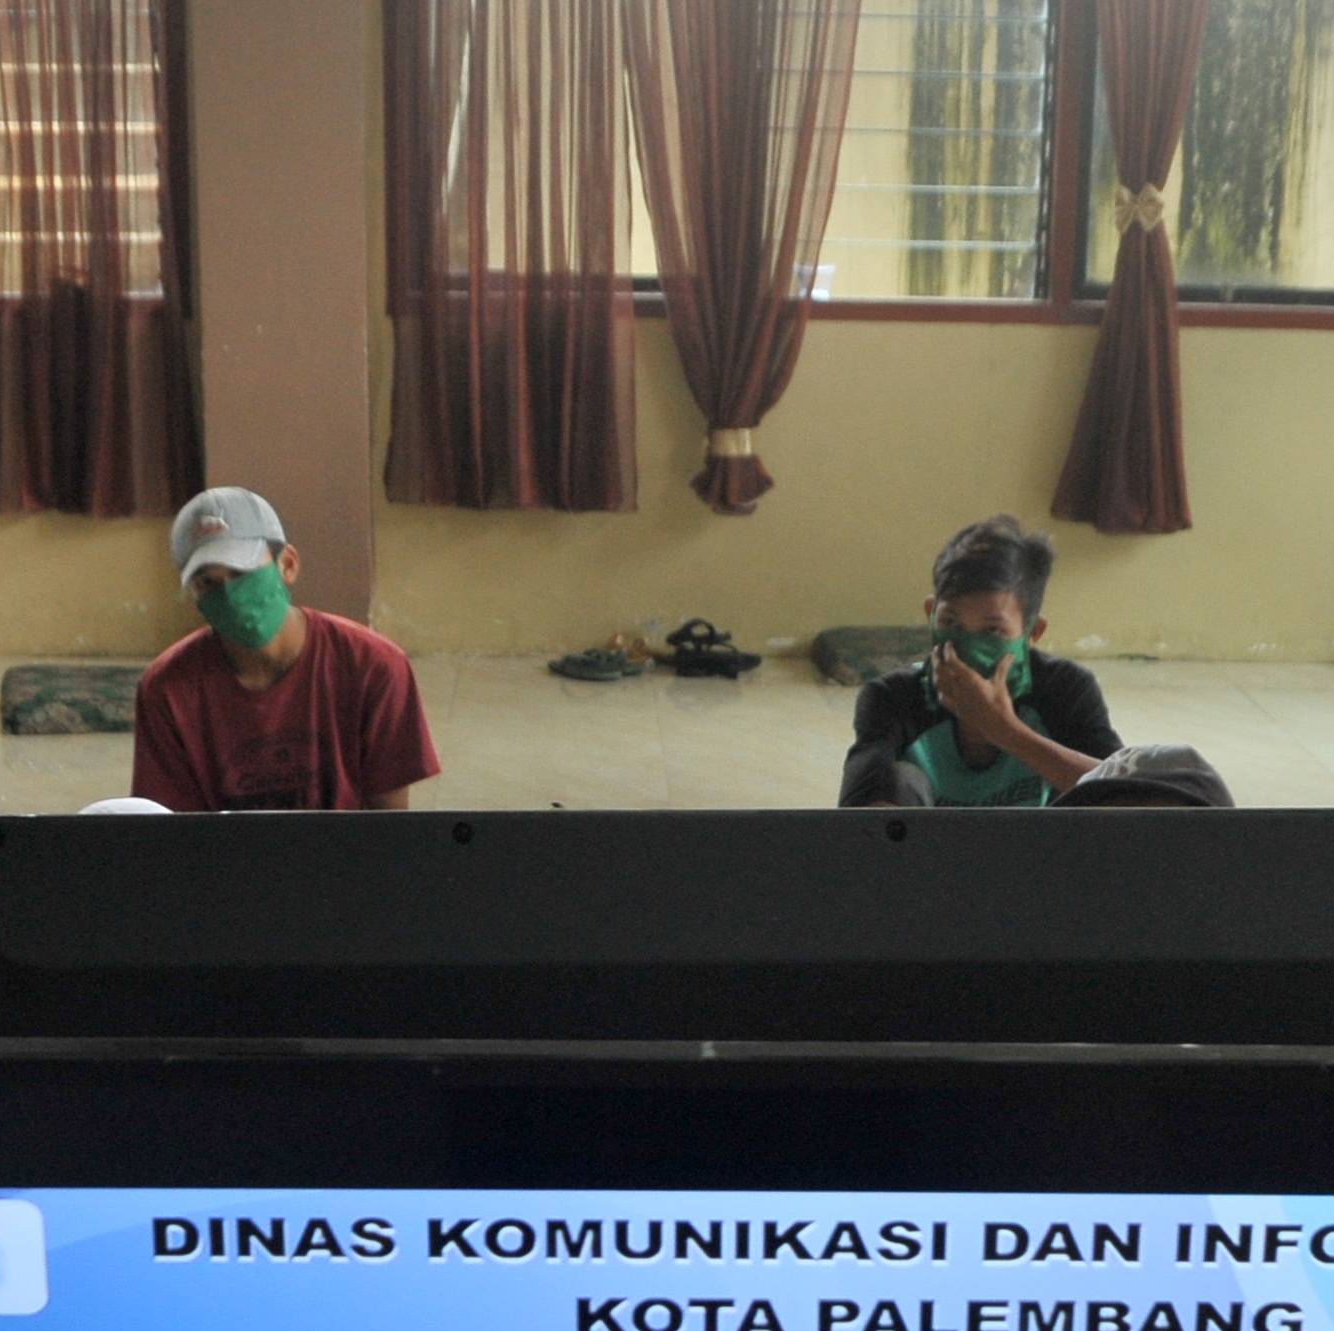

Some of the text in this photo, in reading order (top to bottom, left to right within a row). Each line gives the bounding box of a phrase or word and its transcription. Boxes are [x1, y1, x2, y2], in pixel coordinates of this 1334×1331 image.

[152, 1217, 396, 1259] DINAS
[427, 1218, 949, 1261] KOMUNIKASI
[981, 1221, 1142, 1263] DAN
